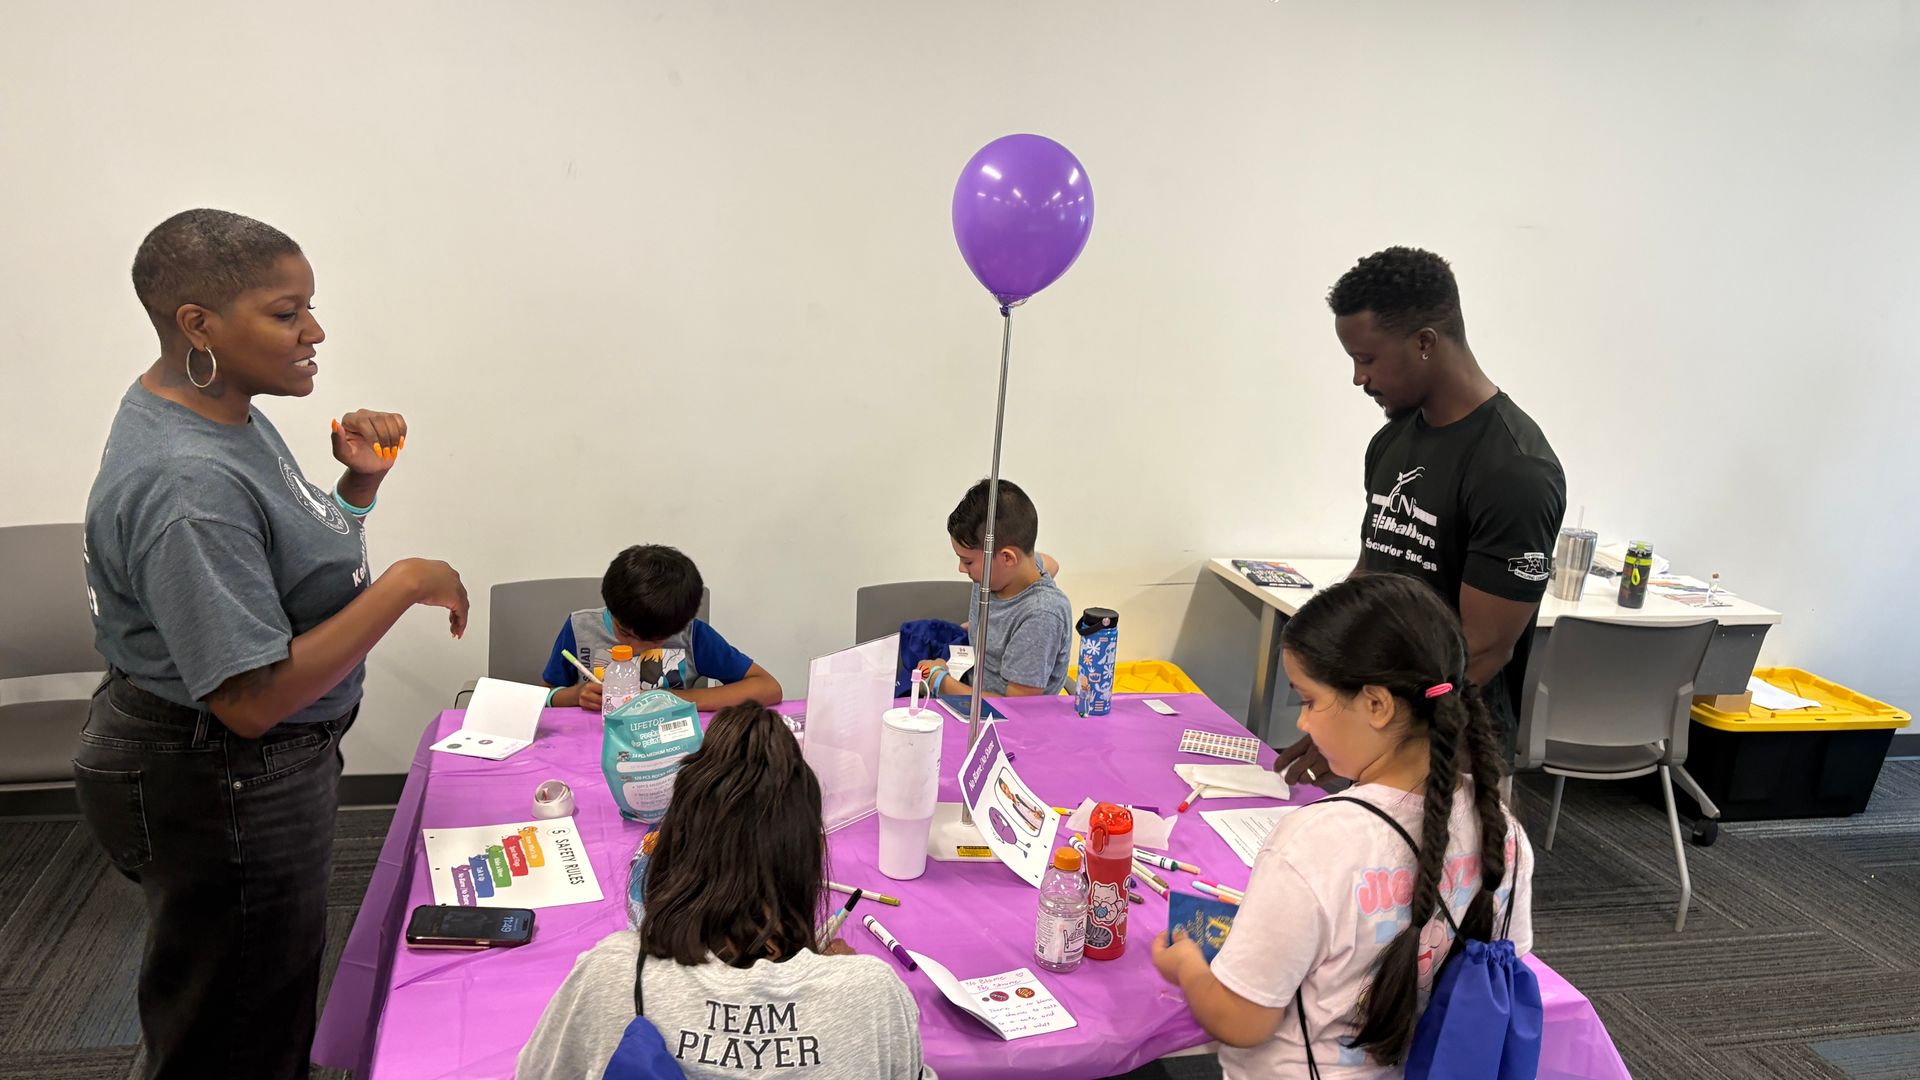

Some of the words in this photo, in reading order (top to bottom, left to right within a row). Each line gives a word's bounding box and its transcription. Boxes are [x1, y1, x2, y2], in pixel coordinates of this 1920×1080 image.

[1389, 492, 1417, 519] CN
[1405, 549, 1437, 571] Sucss
[580, 647, 591, 682] SUAD
[555, 838, 577, 862] SAFETY
[564, 864, 585, 885] RULES
[501, 916, 514, 933] 11:49
[706, 1000, 798, 1035] TEAM
[675, 1030, 821, 1070] PLAYER
